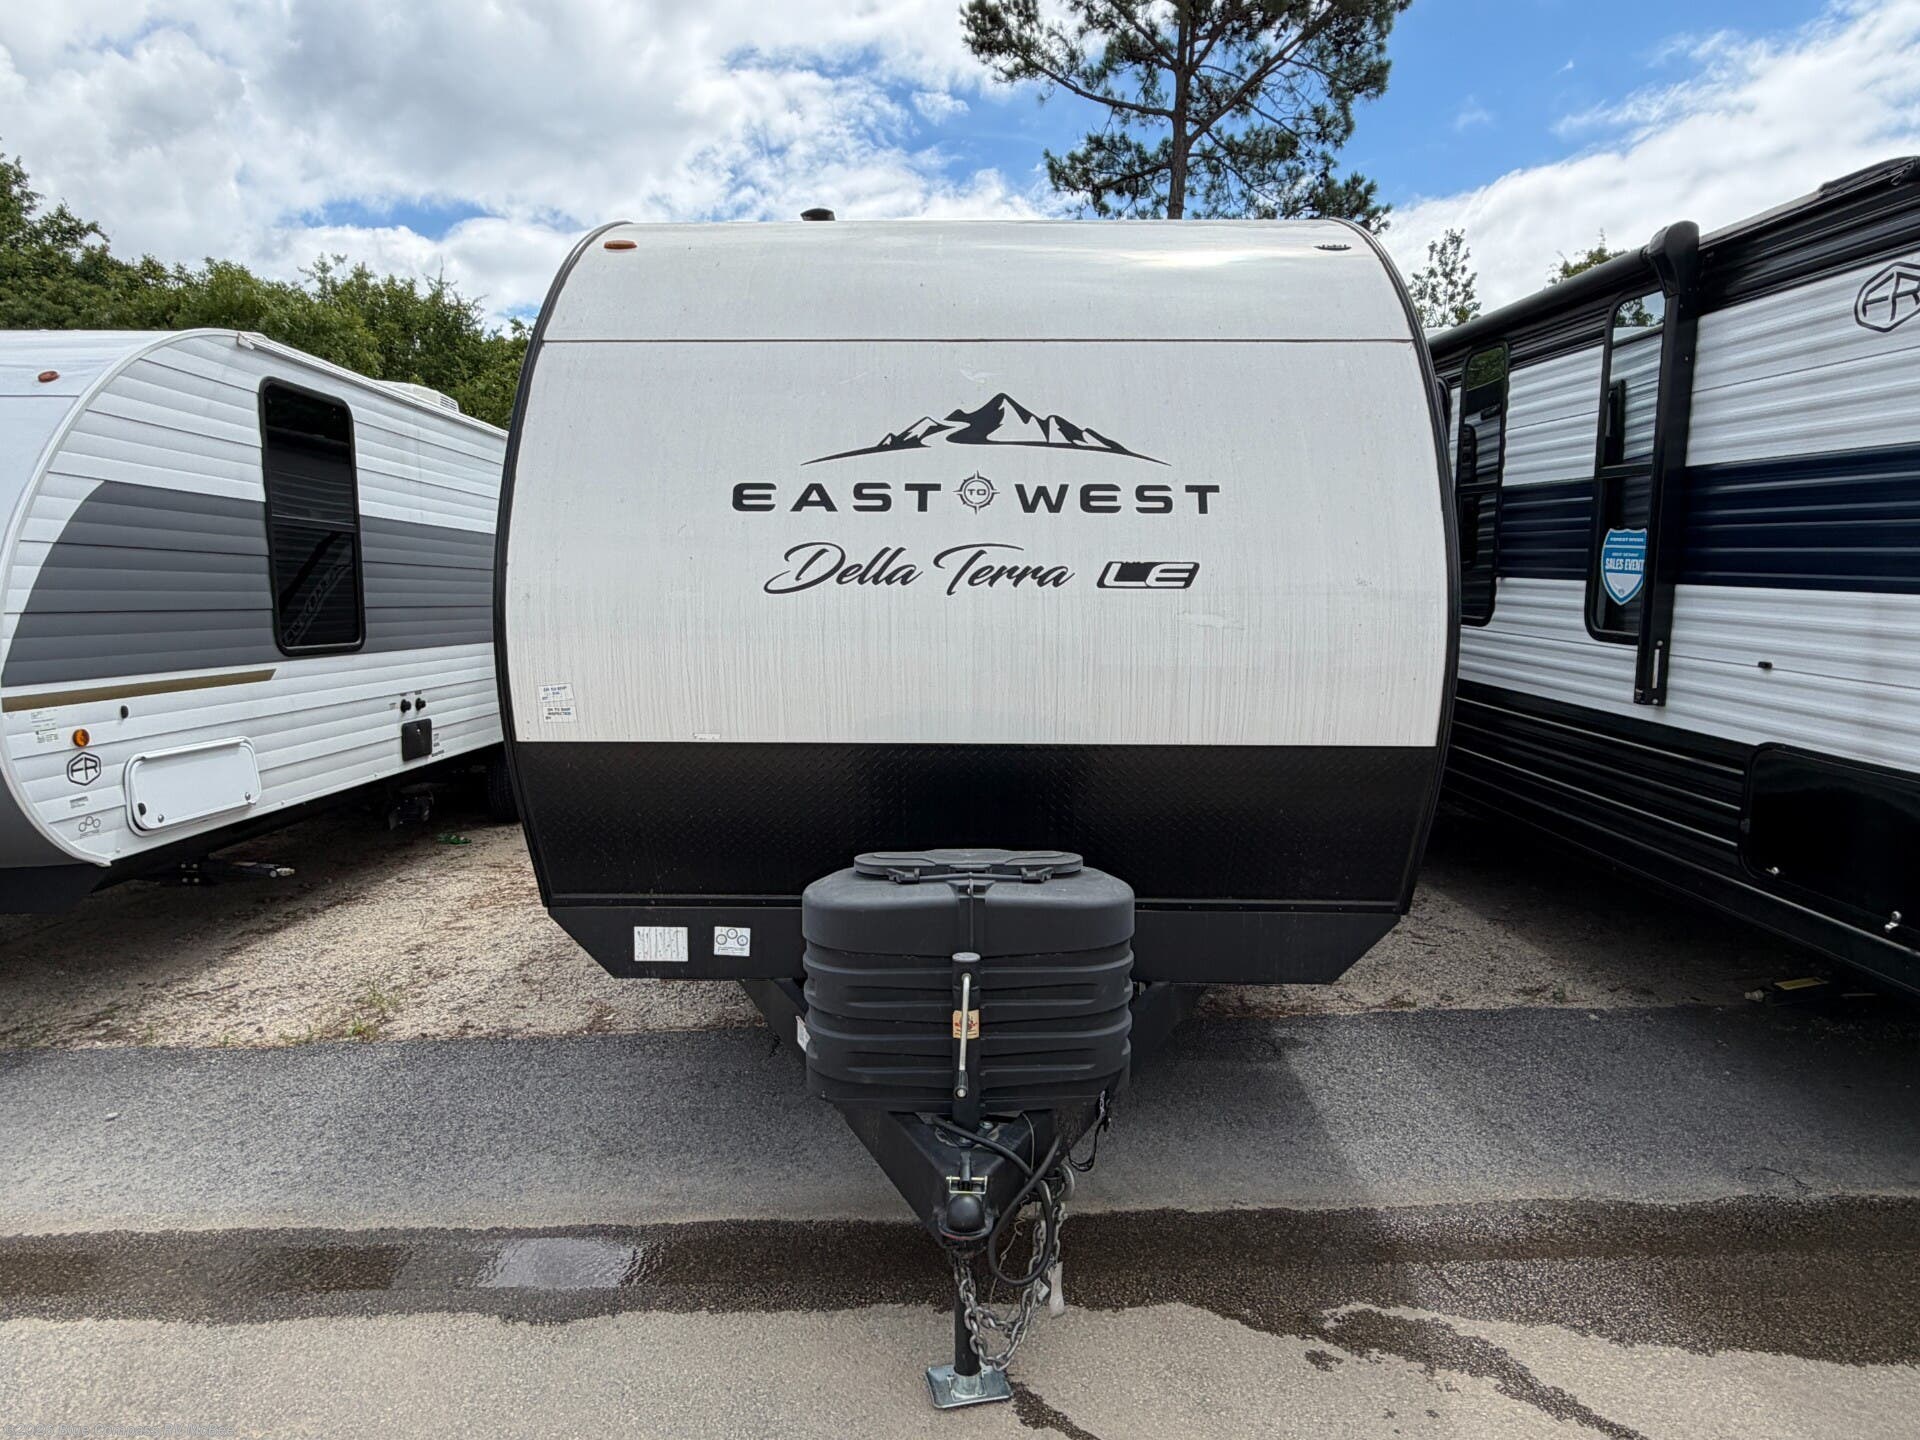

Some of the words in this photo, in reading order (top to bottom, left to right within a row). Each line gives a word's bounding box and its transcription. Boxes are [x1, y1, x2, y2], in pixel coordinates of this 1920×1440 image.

[732, 482, 942, 513] EAST
[966, 488, 987, 497] TO
[1014, 483, 1221, 514] WEST
[763, 541, 924, 595] Della
[932, 542, 1076, 597] Terra
[1605, 557, 1624, 570] SALES
[1624, 558, 1645, 572] EVENT
